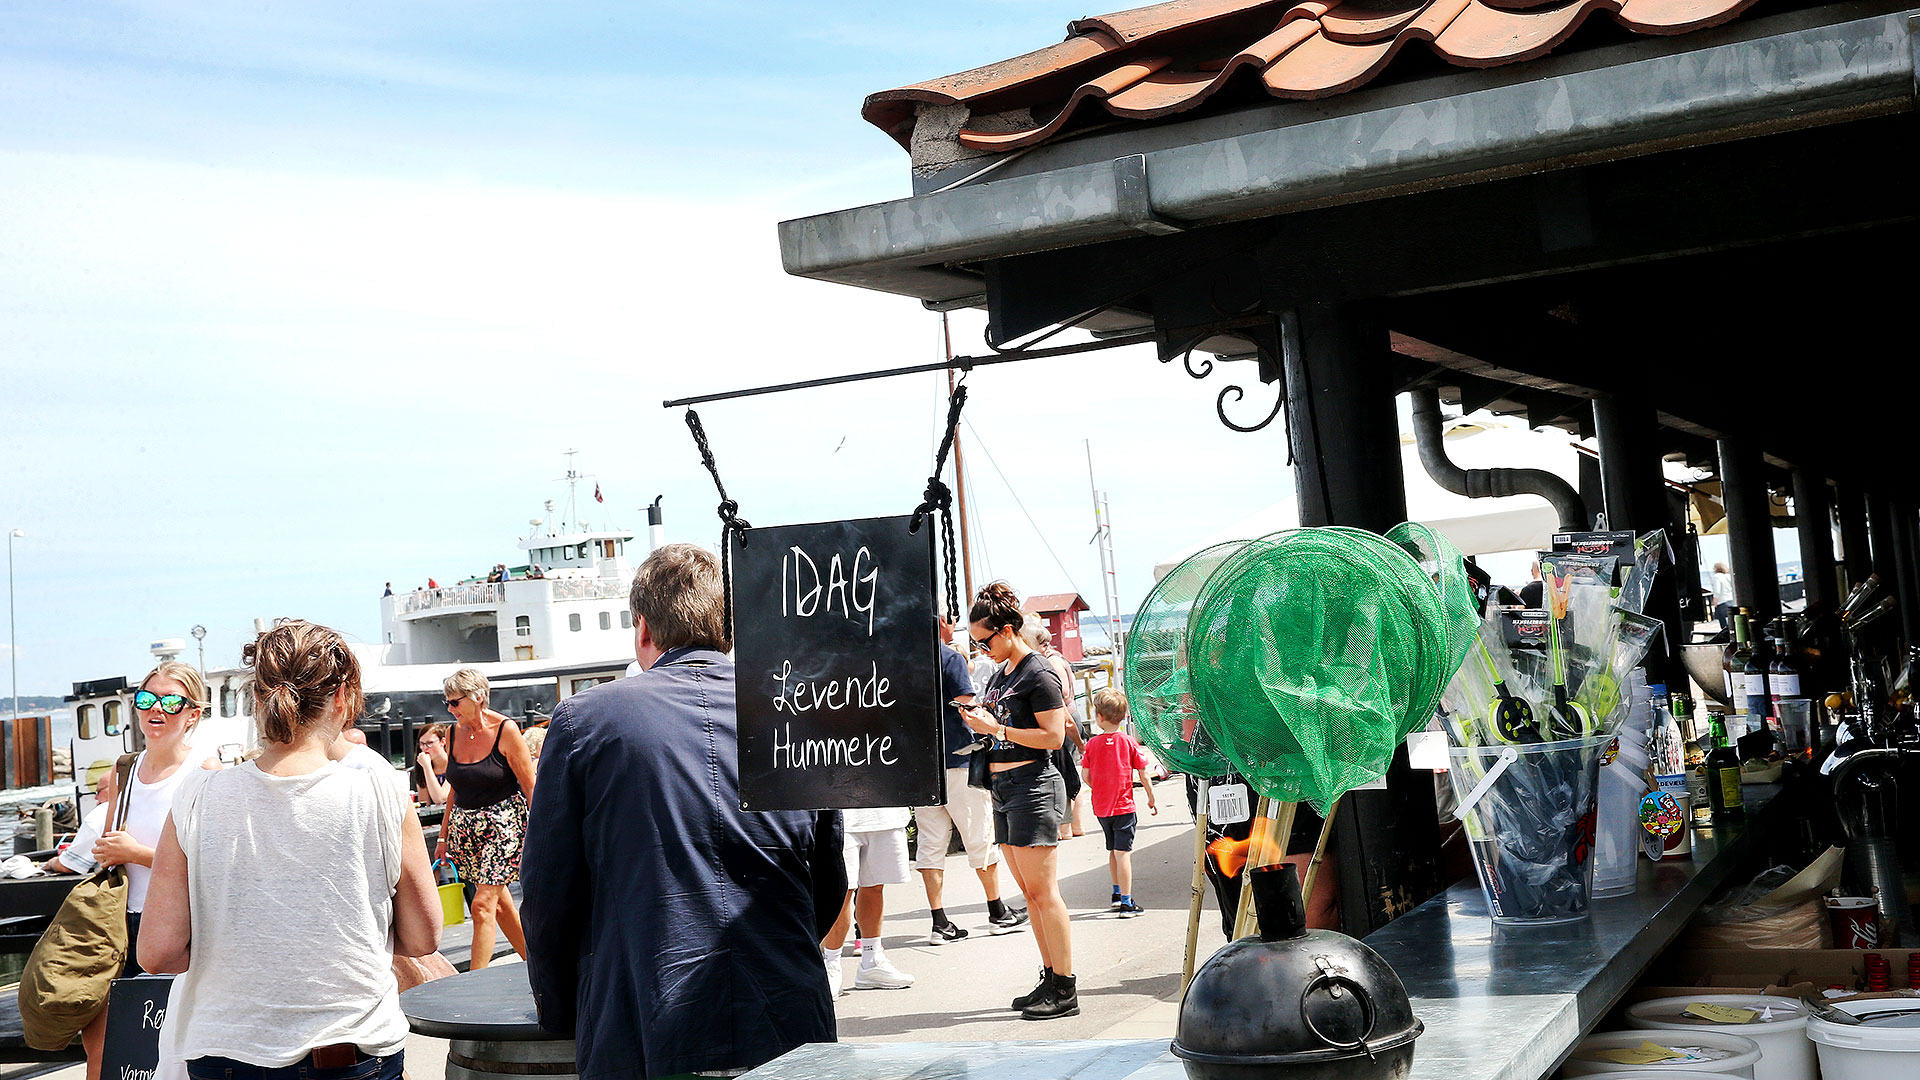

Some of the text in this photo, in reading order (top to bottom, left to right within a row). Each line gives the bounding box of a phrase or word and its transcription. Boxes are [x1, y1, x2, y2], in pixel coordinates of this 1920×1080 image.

[782, 545, 879, 637] IDAG
[772, 659, 896, 716] Levende
[773, 721, 899, 770] Hummere
